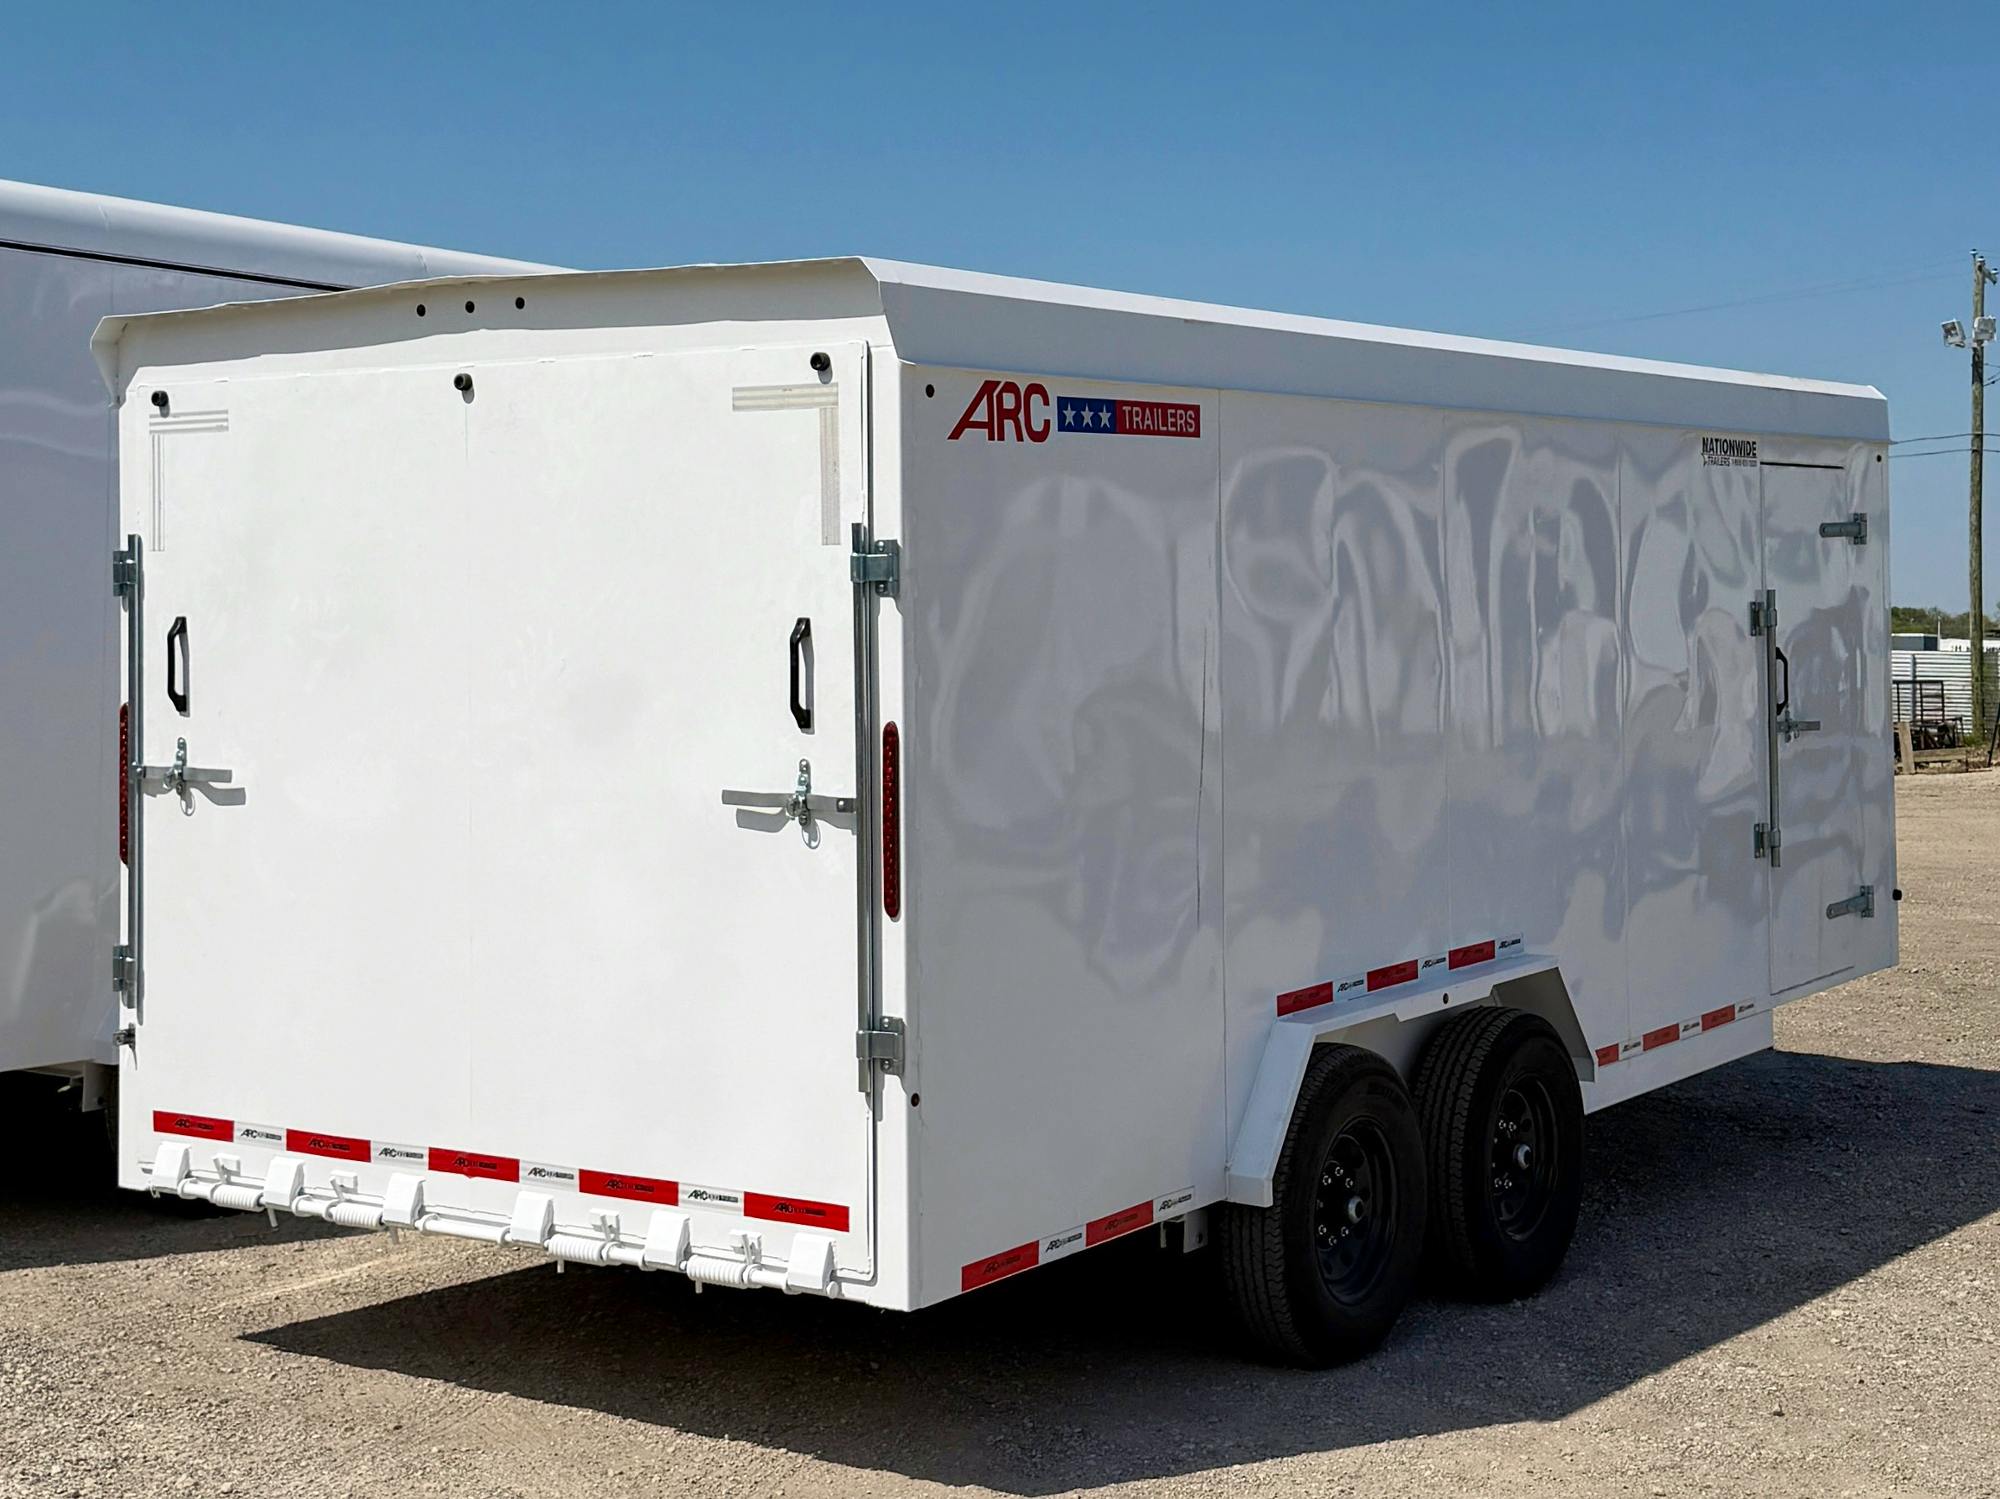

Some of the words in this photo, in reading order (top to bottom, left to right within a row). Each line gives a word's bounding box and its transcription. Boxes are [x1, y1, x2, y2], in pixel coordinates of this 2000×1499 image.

[947, 379, 1051, 443] ARC
[1122, 405, 1196, 433] TRAILERS
[1702, 437, 1757, 457] NATIONWIDE
[240, 1128, 258, 1139] ARC
[379, 1147, 397, 1158] ARC
[528, 1166, 547, 1178] ARC
[688, 1189, 708, 1201] ARC
[1045, 1238, 1061, 1253] ARC
